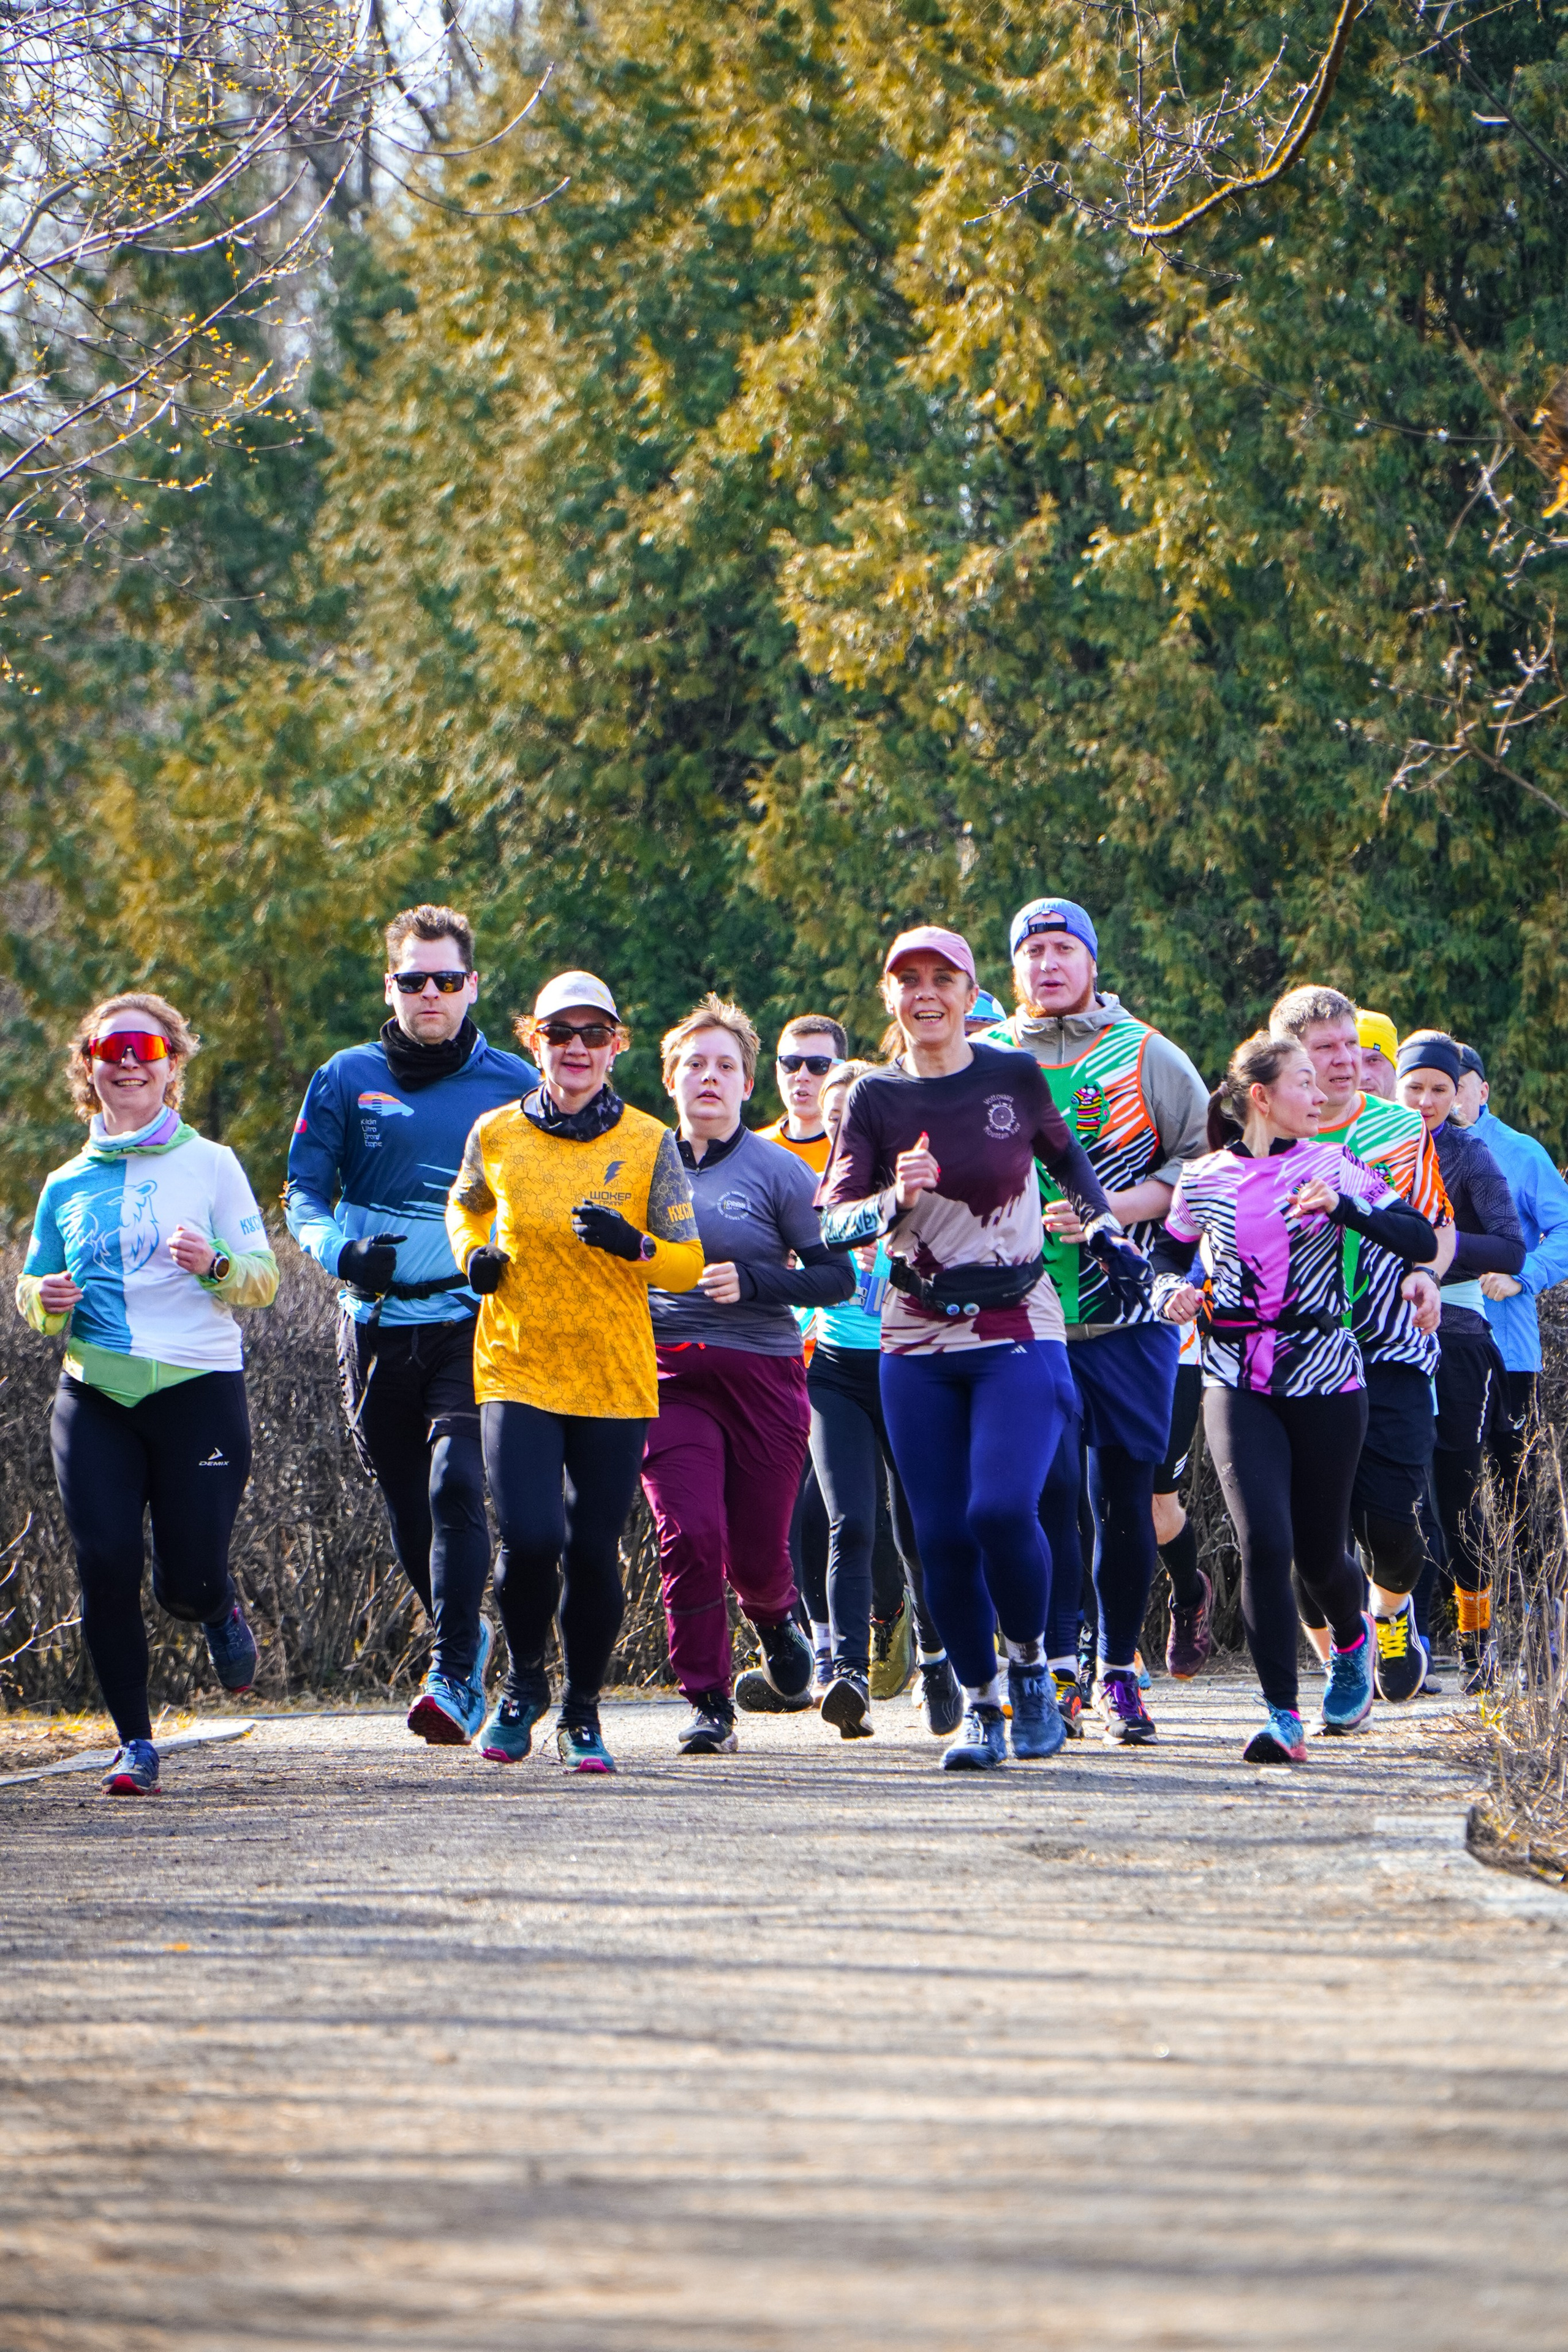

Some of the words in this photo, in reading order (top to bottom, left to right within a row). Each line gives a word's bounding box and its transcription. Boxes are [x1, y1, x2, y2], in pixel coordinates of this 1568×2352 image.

[590, 1191, 631, 1201] ШОКЕР
[667, 1202, 695, 1223] КУСК
[239, 1215, 262, 1235] КУС
